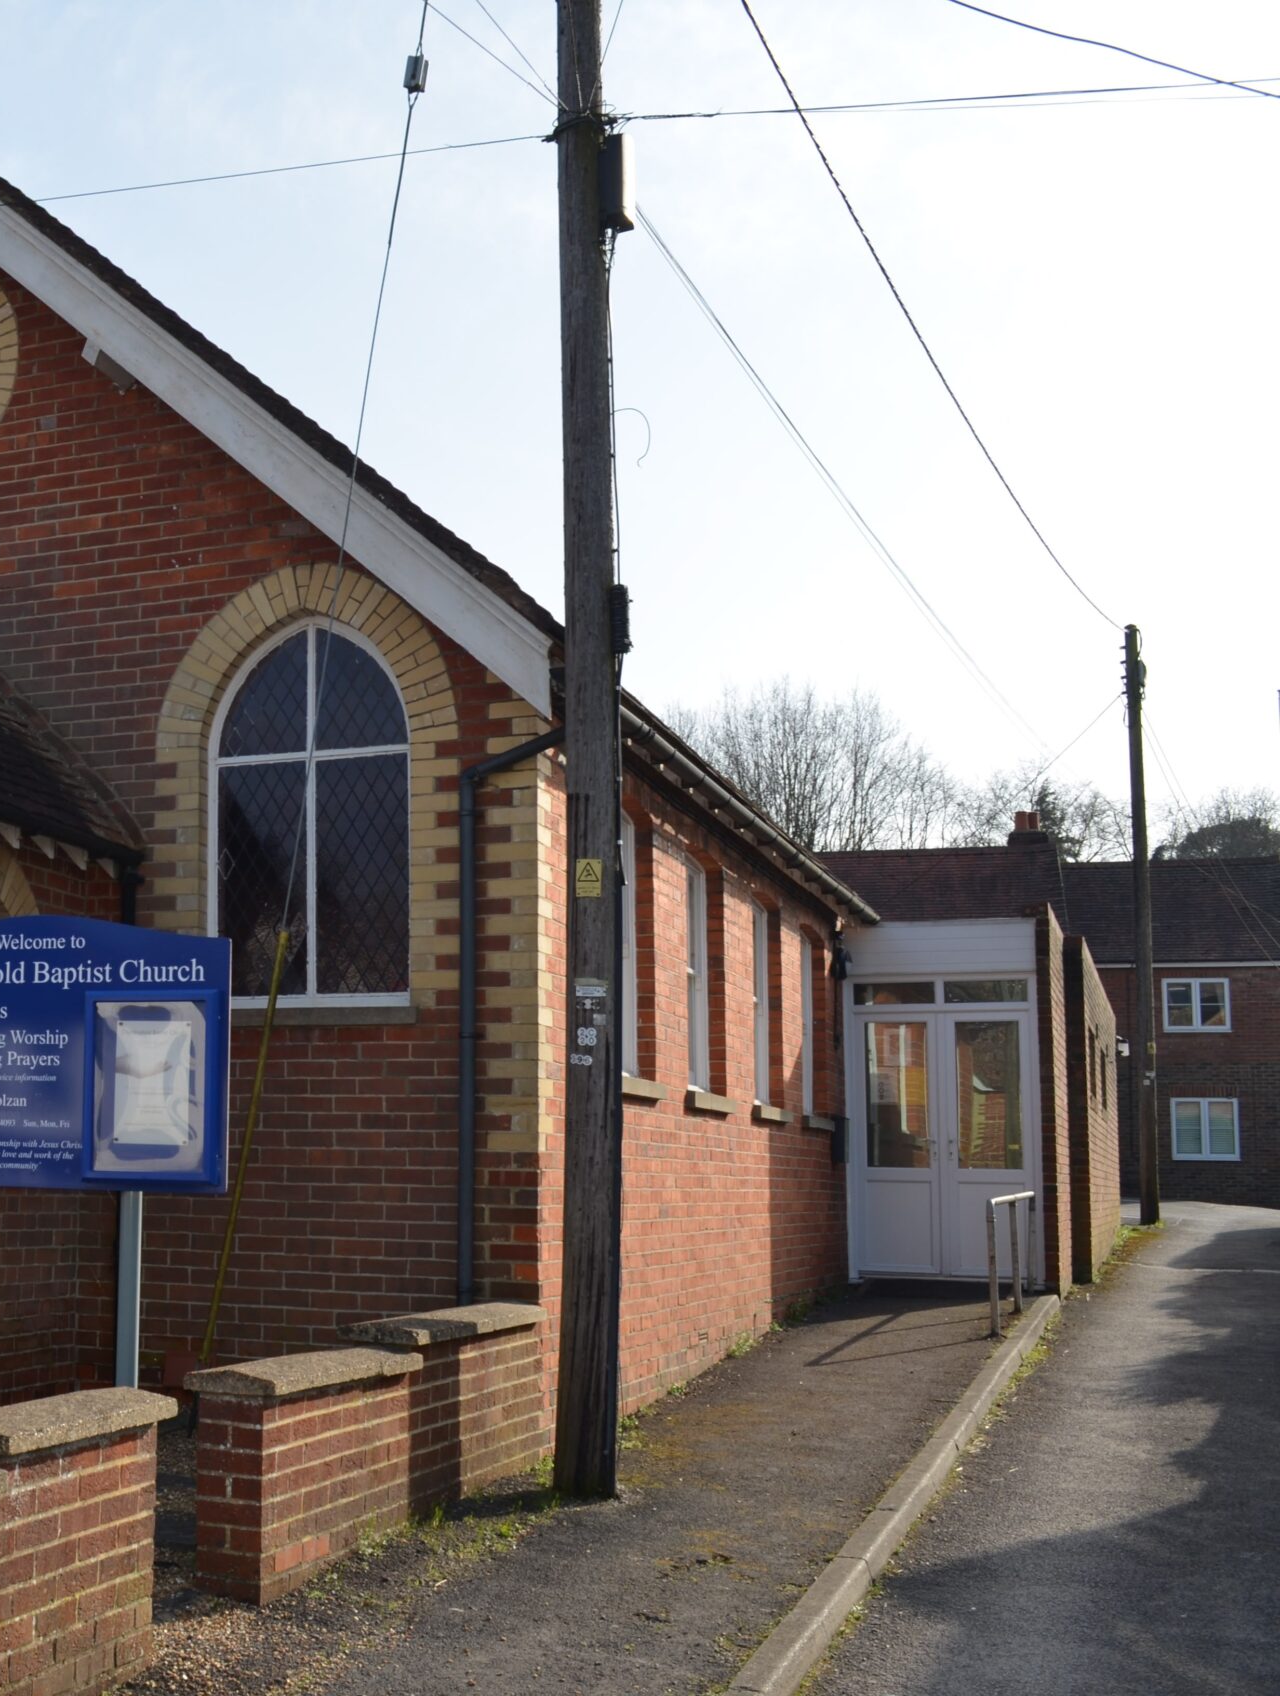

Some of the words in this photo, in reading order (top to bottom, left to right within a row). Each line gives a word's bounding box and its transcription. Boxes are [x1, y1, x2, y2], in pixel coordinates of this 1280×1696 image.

[70, 935, 86, 949] to
[32, 959, 113, 990] Baptist
[119, 957, 206, 983] Church
[10, 1030, 69, 1048] Worship
[7, 1051, 61, 1069] Prayers
[15, 1073, 57, 1083] information
[59, 1120, 70, 1129] Fri
[22, 1139, 38, 1148] with
[39, 1139, 59, 1149] Jesus
[1, 1149, 17, 1159] love
[18, 1150, 33, 1159] and
[33, 1150, 52, 1160] work
[53, 1151, 63, 1162] of
[62, 1151, 74, 1160] the
